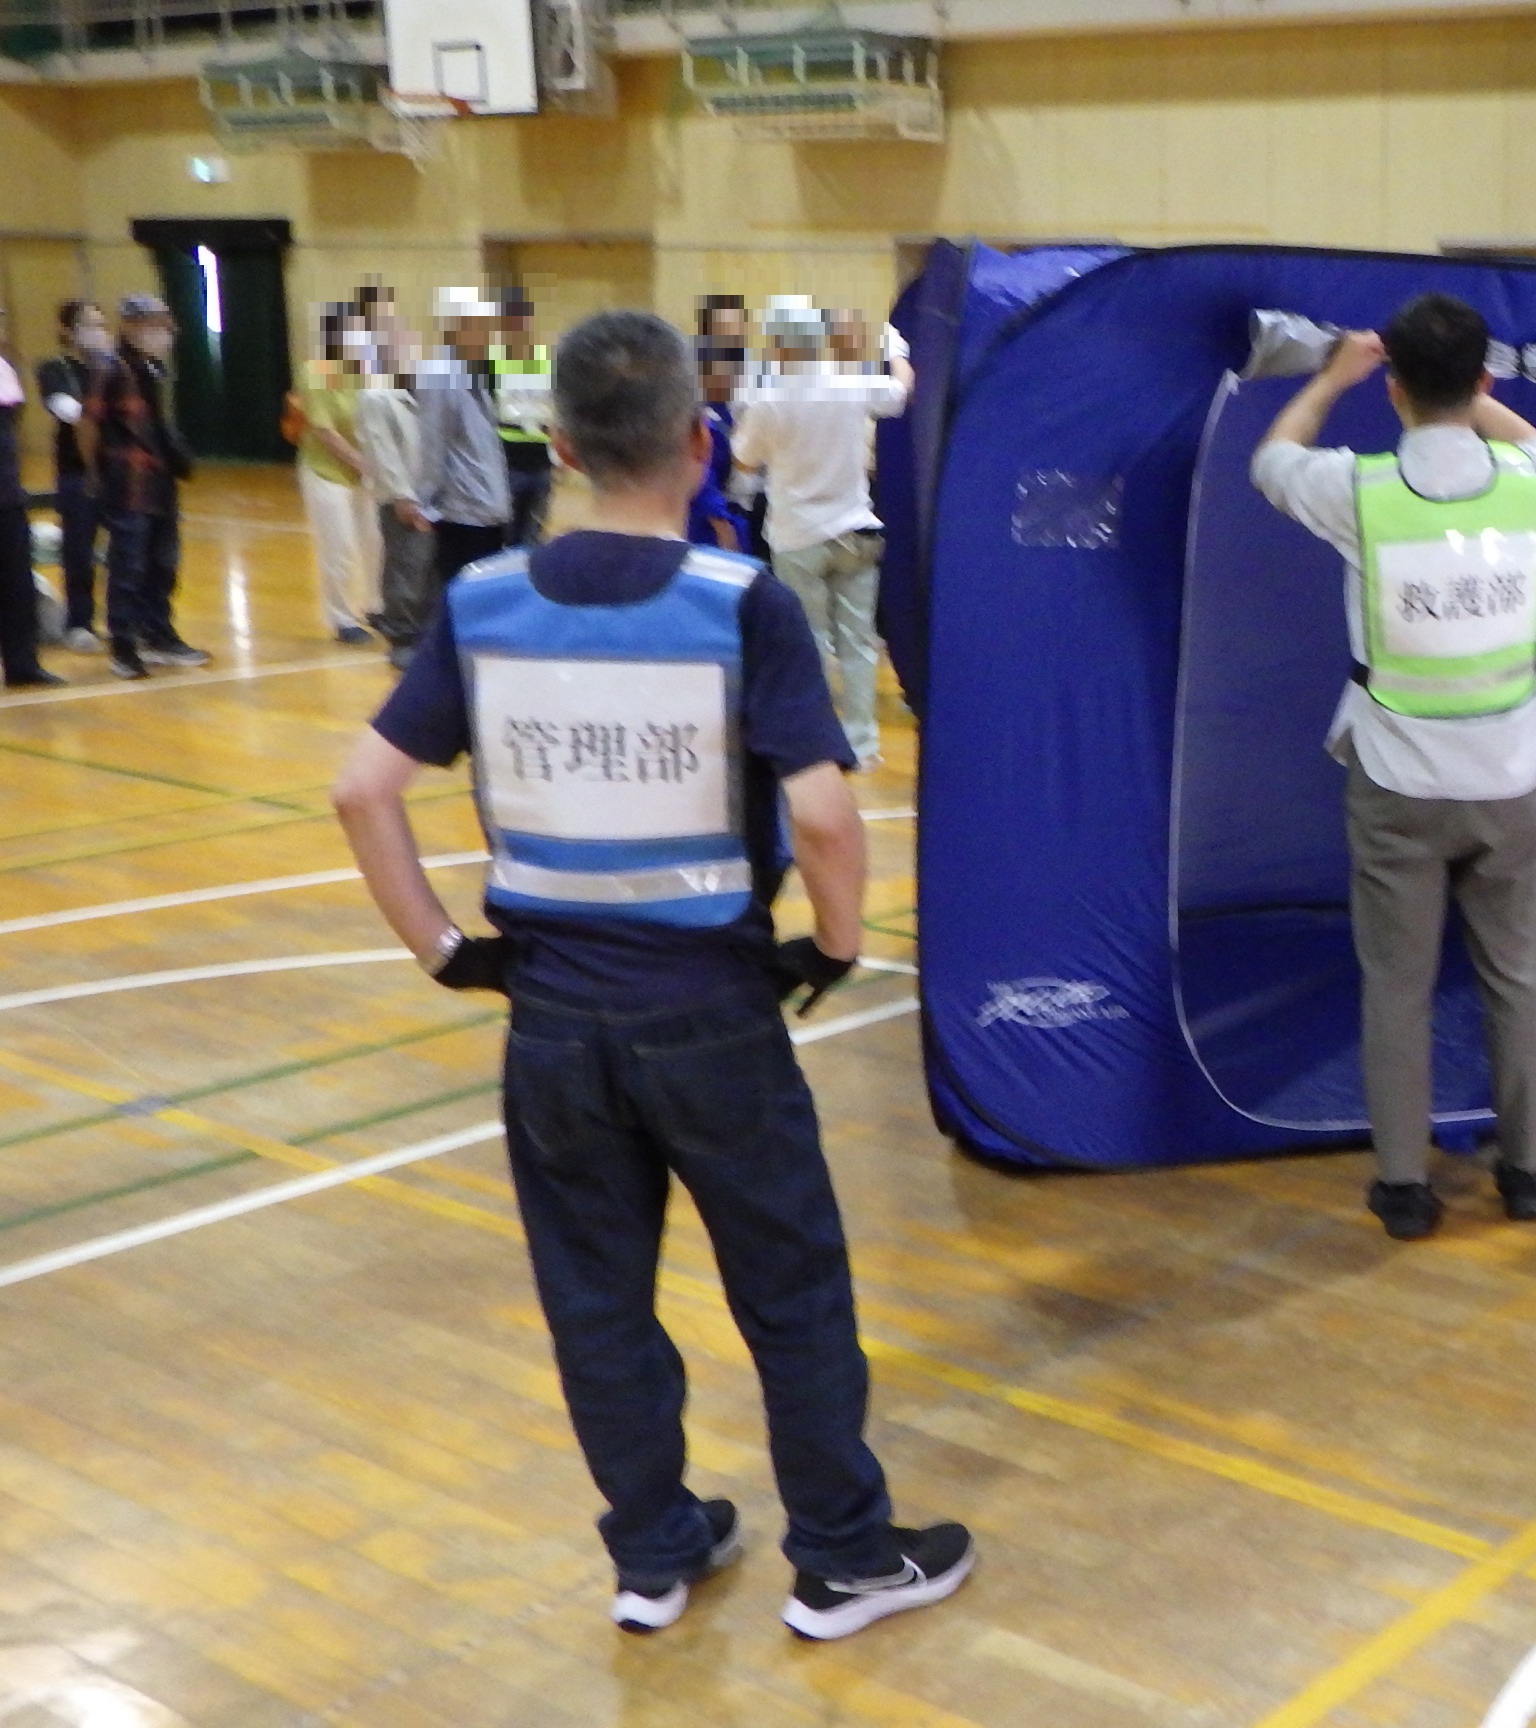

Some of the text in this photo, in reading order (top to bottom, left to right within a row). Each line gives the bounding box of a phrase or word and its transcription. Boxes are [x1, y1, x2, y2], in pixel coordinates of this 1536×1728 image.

[1396, 571, 1527, 623] 救護部
[502, 716, 698, 783] 管理部
